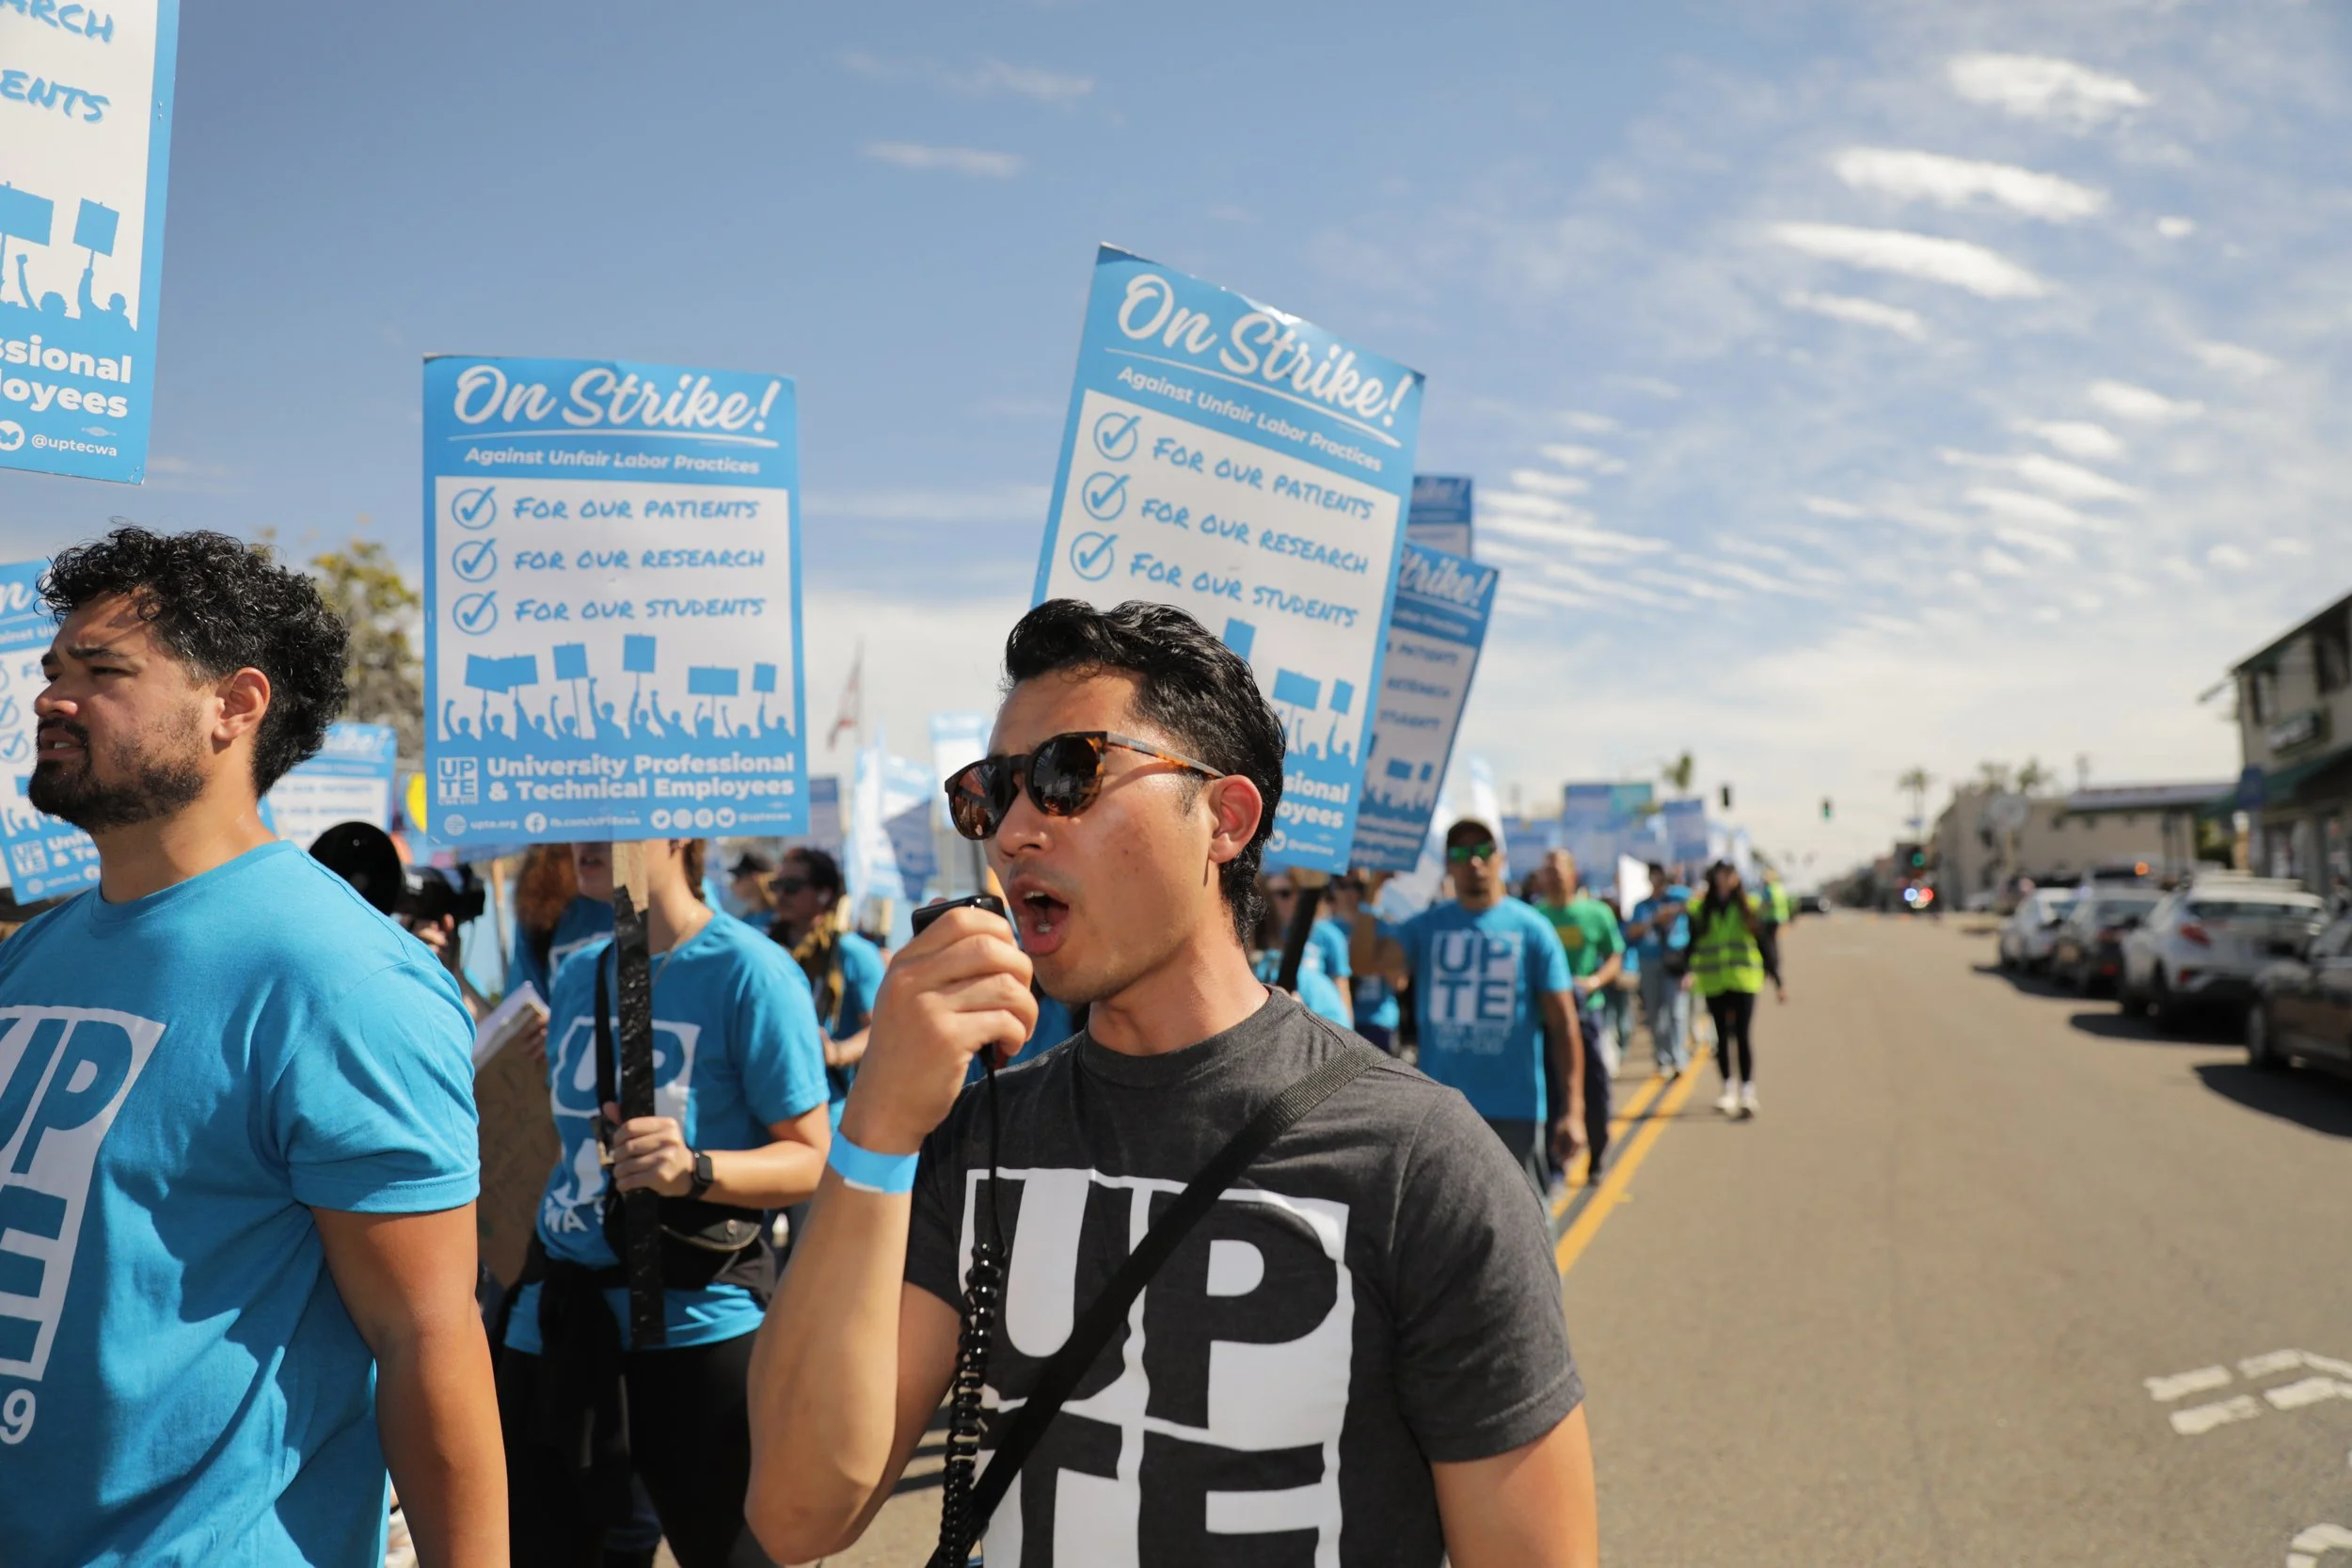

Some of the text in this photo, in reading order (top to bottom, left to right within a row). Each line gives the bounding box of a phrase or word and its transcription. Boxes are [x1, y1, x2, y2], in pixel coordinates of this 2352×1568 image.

[0, 334, 132, 384] sional
[1118, 274, 1413, 427] On Strike!
[0, 368, 128, 418] oyees
[453, 365, 782, 433] On Strike!
[1118, 367, 1383, 471] Against Unfair Labor Practices
[31, 434, 118, 456] @uptecwa
[465, 447, 760, 474] Against Unfair Labor Practices
[1152, 438, 1204, 473] FOR
[1215, 459, 1263, 489] OUR
[1273, 475, 1375, 519] PATIENTS
[514, 497, 760, 519] FOR OUR PATIENTS
[1141, 499, 1369, 574] FOR OUR RESEARCH
[514, 549, 766, 570] FOR OUR RESEARCH
[514, 598, 766, 622] FOR OUR STUDENTS
[1130, 553, 1182, 588] FOR
[1192, 572, 1243, 601] OUR
[1253, 586, 1359, 627] STUDENTS
[487, 751, 795, 780] University Professional
[488, 776, 795, 801] & Technical Employees
[1438, 935, 1513, 974] UP
[1438, 979, 1509, 1020] TE
[974, 1178, 1338, 1430] UP
